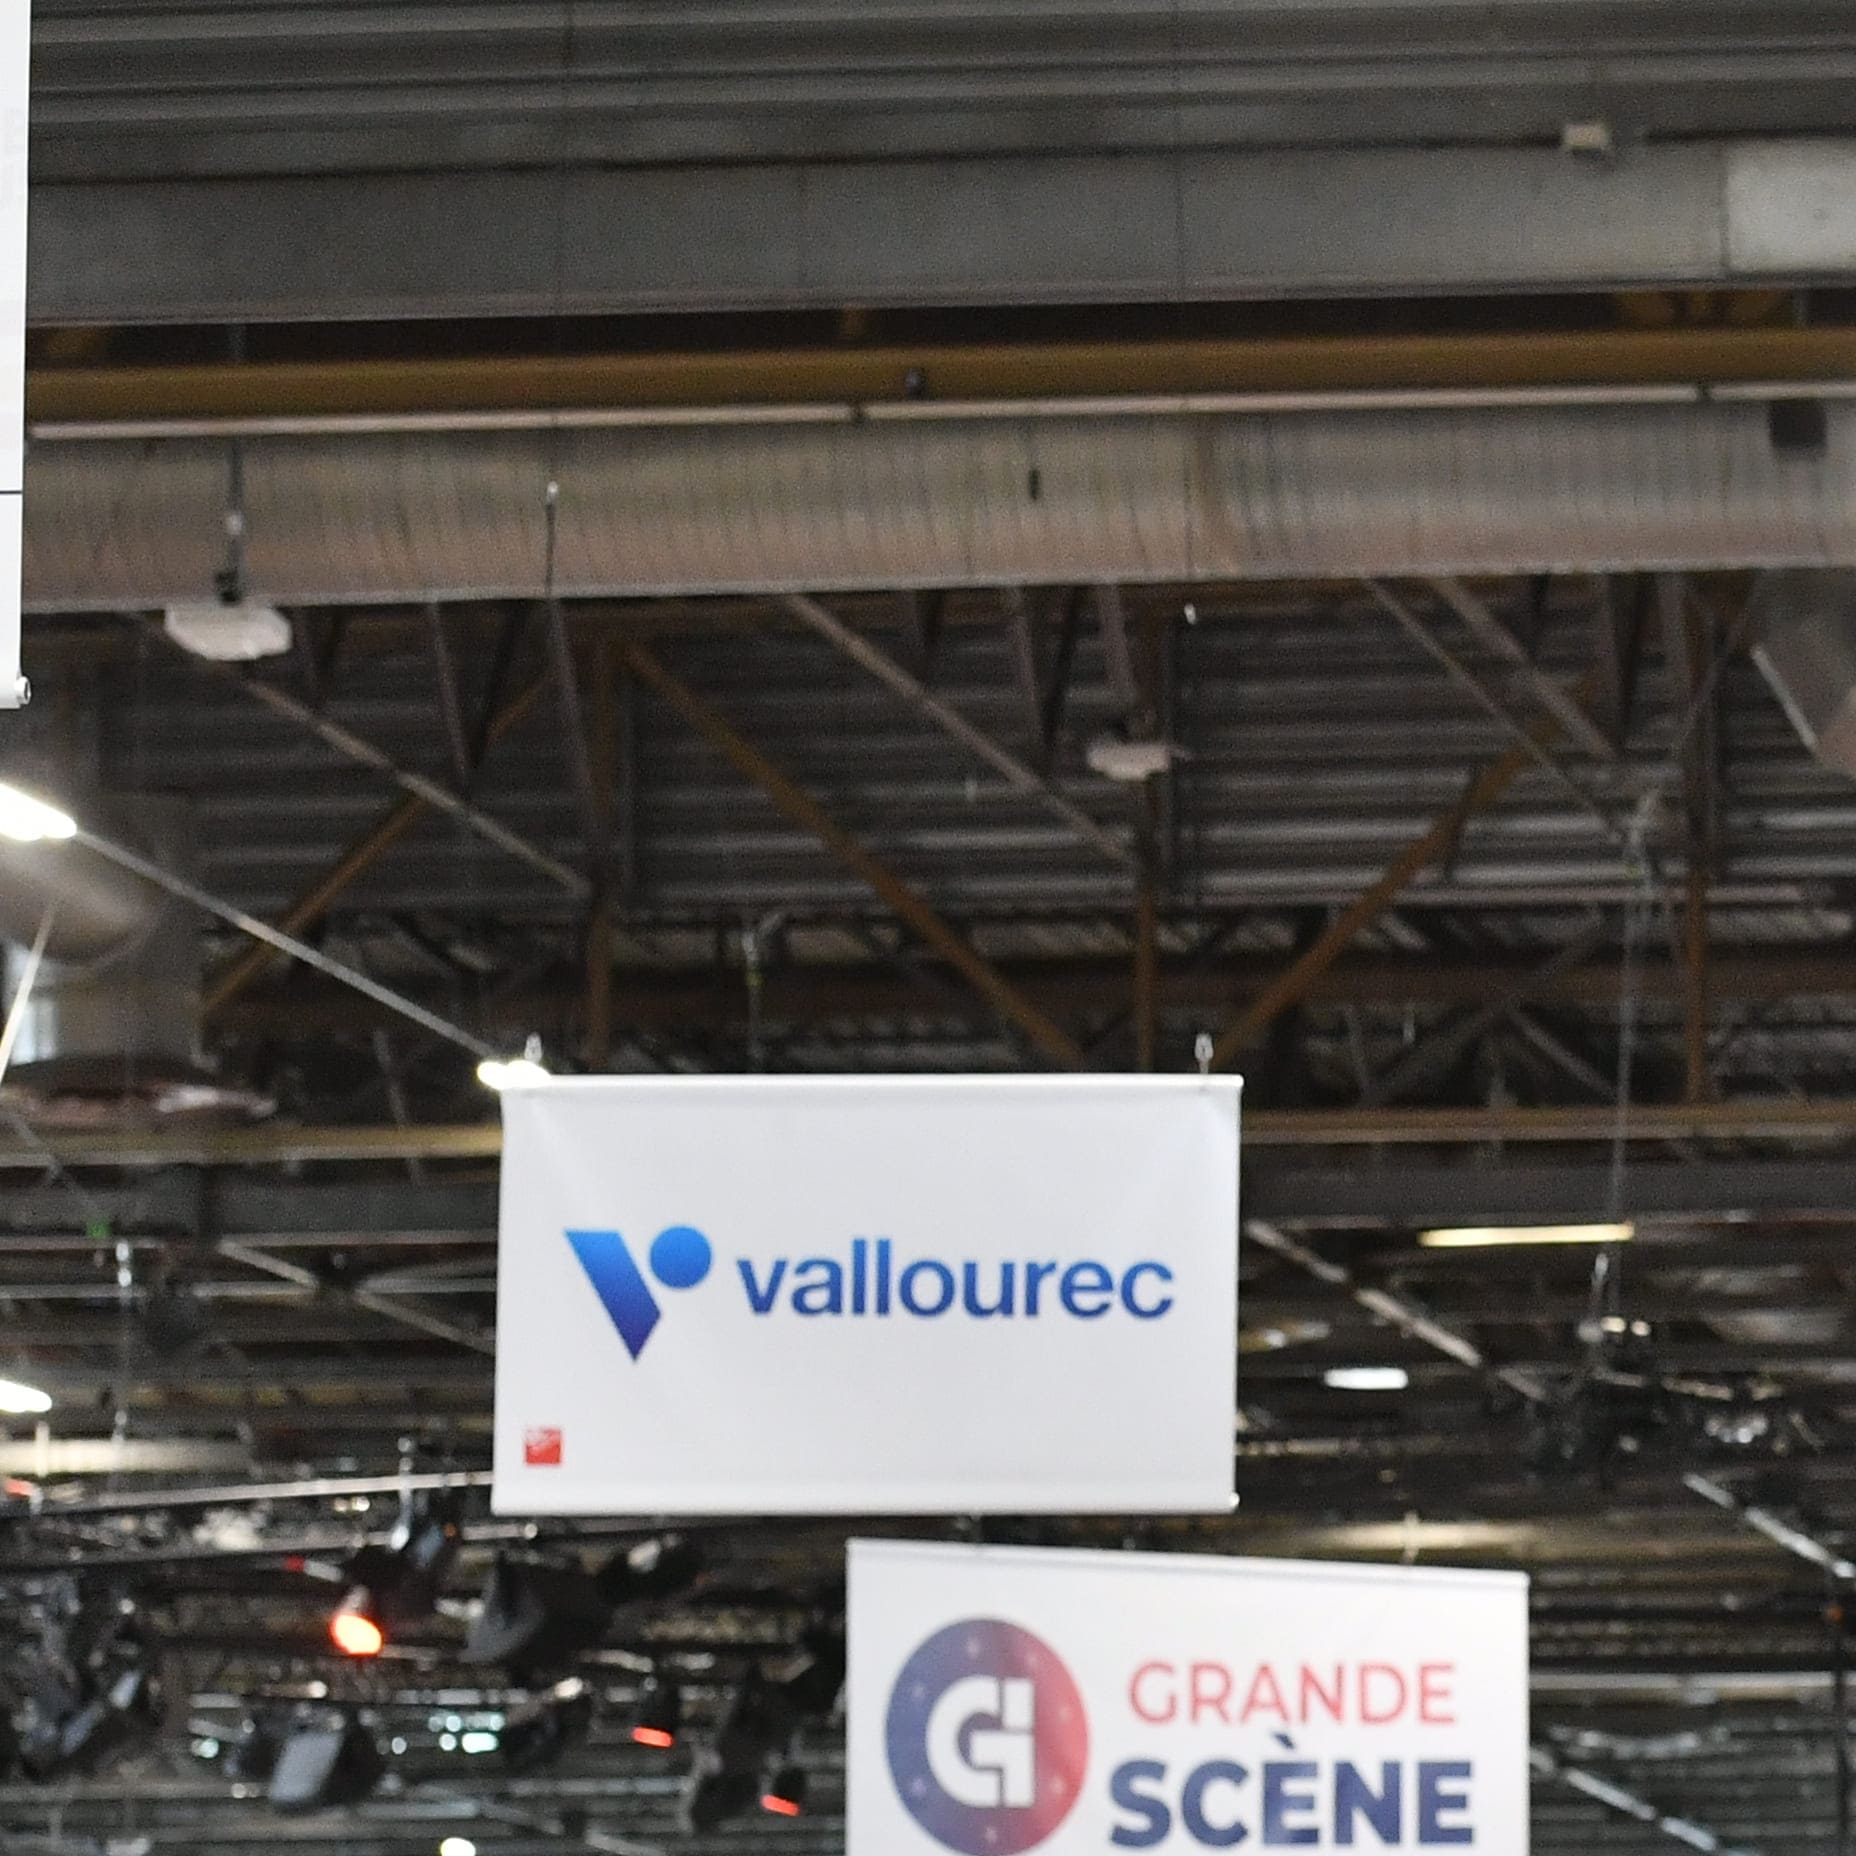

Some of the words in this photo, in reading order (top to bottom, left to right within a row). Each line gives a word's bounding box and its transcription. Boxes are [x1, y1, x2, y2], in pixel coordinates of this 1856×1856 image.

[736, 1238, 1176, 1321] vallourec
[1128, 1660, 1458, 1727] GRANDE
[1108, 1733, 1475, 1850] SCÈNE
